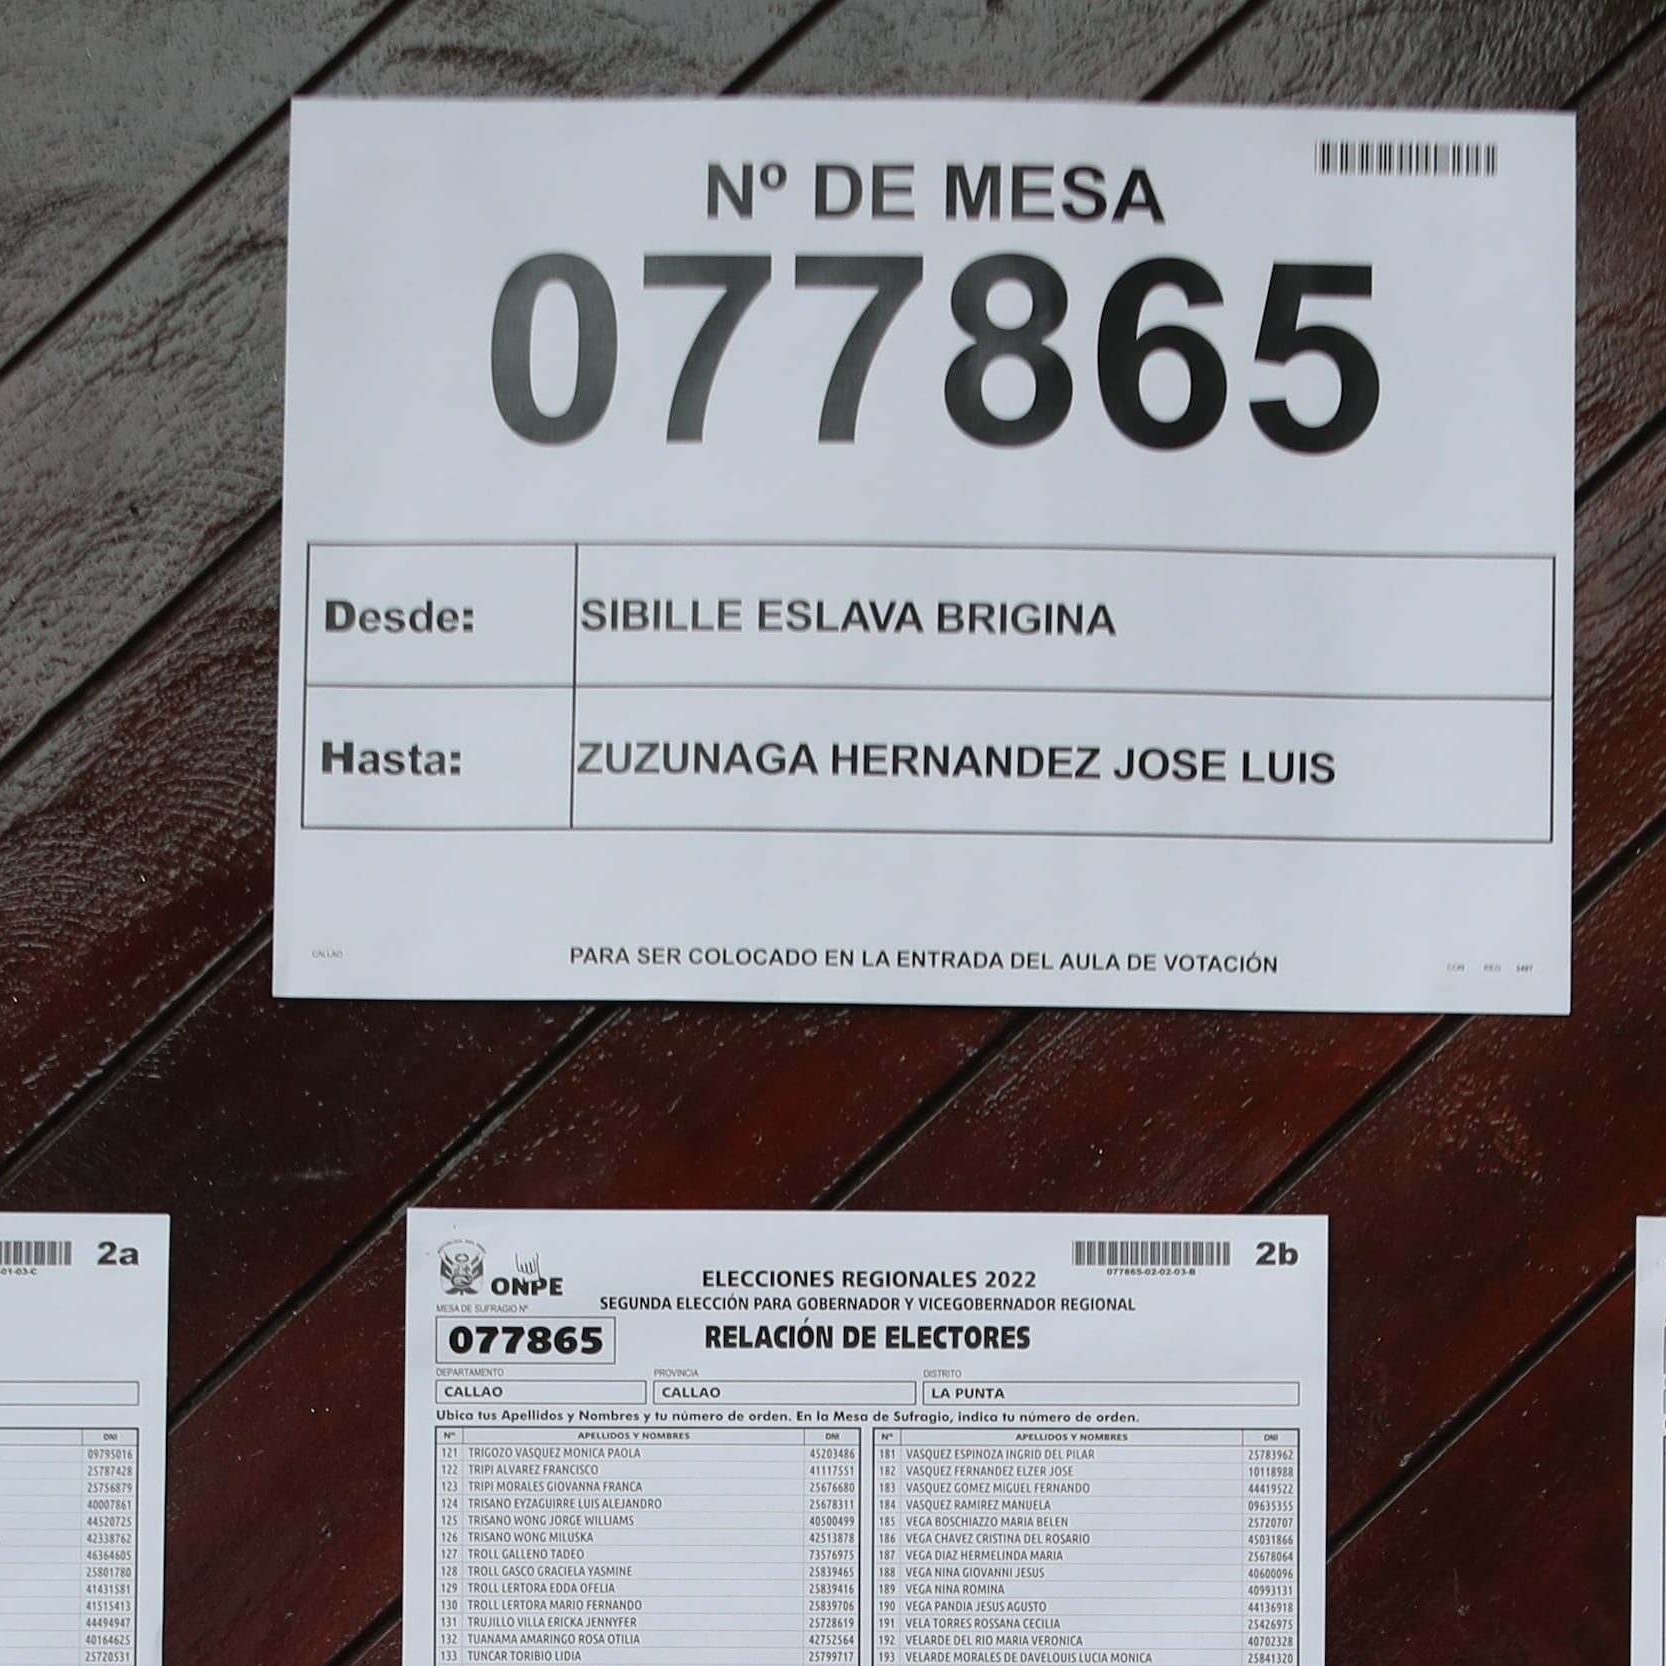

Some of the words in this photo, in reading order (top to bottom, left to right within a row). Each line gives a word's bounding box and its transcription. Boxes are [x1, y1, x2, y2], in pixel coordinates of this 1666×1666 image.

[707, 163, 786, 219] Nº
[814, 163, 914, 219] DE
[945, 163, 1165, 224] MESA
[491, 252, 1380, 456] 077865
[325, 599, 473, 633] Desde:
[581, 599, 741, 630] SIBILLE
[758, 599, 923, 632] ESLAVA
[937, 601, 1116, 635] BRIGINA
[321, 740, 460, 775] Hasta:
[578, 742, 818, 774] ZUZUNAGA
[832, 743, 1100, 779] HERNANDEZ
[1113, 747, 1226, 781] JOSE
[1242, 750, 1335, 784] LUIS
[570, 947, 629, 964] PARA
[637, 947, 680, 964] SER
[688, 948, 817, 966] COLOCADO
[825, 949, 853, 966] EN
[862, 950, 890, 967] LA
[897, 950, 1003, 969] ENTRADA
[1010, 952, 1053, 969] DEL
[1059, 953, 1120, 970] AULA
[1127, 953, 1155, 970] DE
[1164, 951, 1277, 973] VOTACIÓN
[97, 1241, 138, 1265] 2a
[1255, 1241, 1298, 1265] 2b
[491, 1274, 563, 1296] ONPE
[703, 1270, 834, 1287] ELECCIONES
[842, 1270, 976, 1287] REGIONALES
[985, 1271, 1035, 1287] 2022
[600, 1296, 672, 1310] SEGUNDA
[676, 1294, 748, 1310] ELECCIÓN
[754, 1297, 792, 1310] PARA
[796, 1297, 900, 1310] GOBERNADOR
[904, 1297, 913, 1310] Y
[918, 1297, 1055, 1310] VICEGOBERNADOR
[1061, 1297, 1135, 1310] REGIONAL
[448, 1325, 602, 1354] 077865
[705, 1317, 833, 1348] RELACIÓN
[843, 1325, 876, 1349] DE
[885, 1325, 1030, 1349] ELECTORES
[435, 1367, 504, 1376] DEPARTAMENTO
[653, 1368, 699, 1377] PROVINCIA
[444, 1386, 502, 1397] CALLAO
[662, 1387, 720, 1398] CALLAO
[932, 1388, 950, 1398] LA
[955, 1387, 1004, 1398] PUNTA
[436, 1409, 473, 1420] Ubica
[478, 1410, 496, 1420] tus
[501, 1409, 563, 1423] Apellidos
[567, 1413, 574, 1423] y
[579, 1409, 639, 1421] Nombres
[643, 1413, 650, 1423] y
[655, 1411, 667, 1421] tu
[672, 1410, 723, 1421] número
[727, 1410, 744, 1421] de
[748, 1410, 791, 1421] orden.
[796, 1410, 811, 1421] En
[816, 1410, 828, 1421] la
[833, 1410, 868, 1421] Mesa
[872, 1410, 889, 1421] de
[893, 1410, 953, 1424] Sufragio,
[958, 1410, 997, 1422] indica
[1002, 1412, 1014, 1422] tu
[1019, 1411, 1070, 1422] número
[1075, 1411, 1091, 1422] de
[1096, 1411, 1139, 1422] orden.
[467, 1548, 499, 1559] TROLL
[501, 1548, 548, 1559] GALLENO
[550, 1548, 584, 1559] TADEO
[905, 1583, 932, 1594] VEGA
[934, 1583, 960, 1594] NINA
[962, 1583, 1004, 1594] ROMINA
